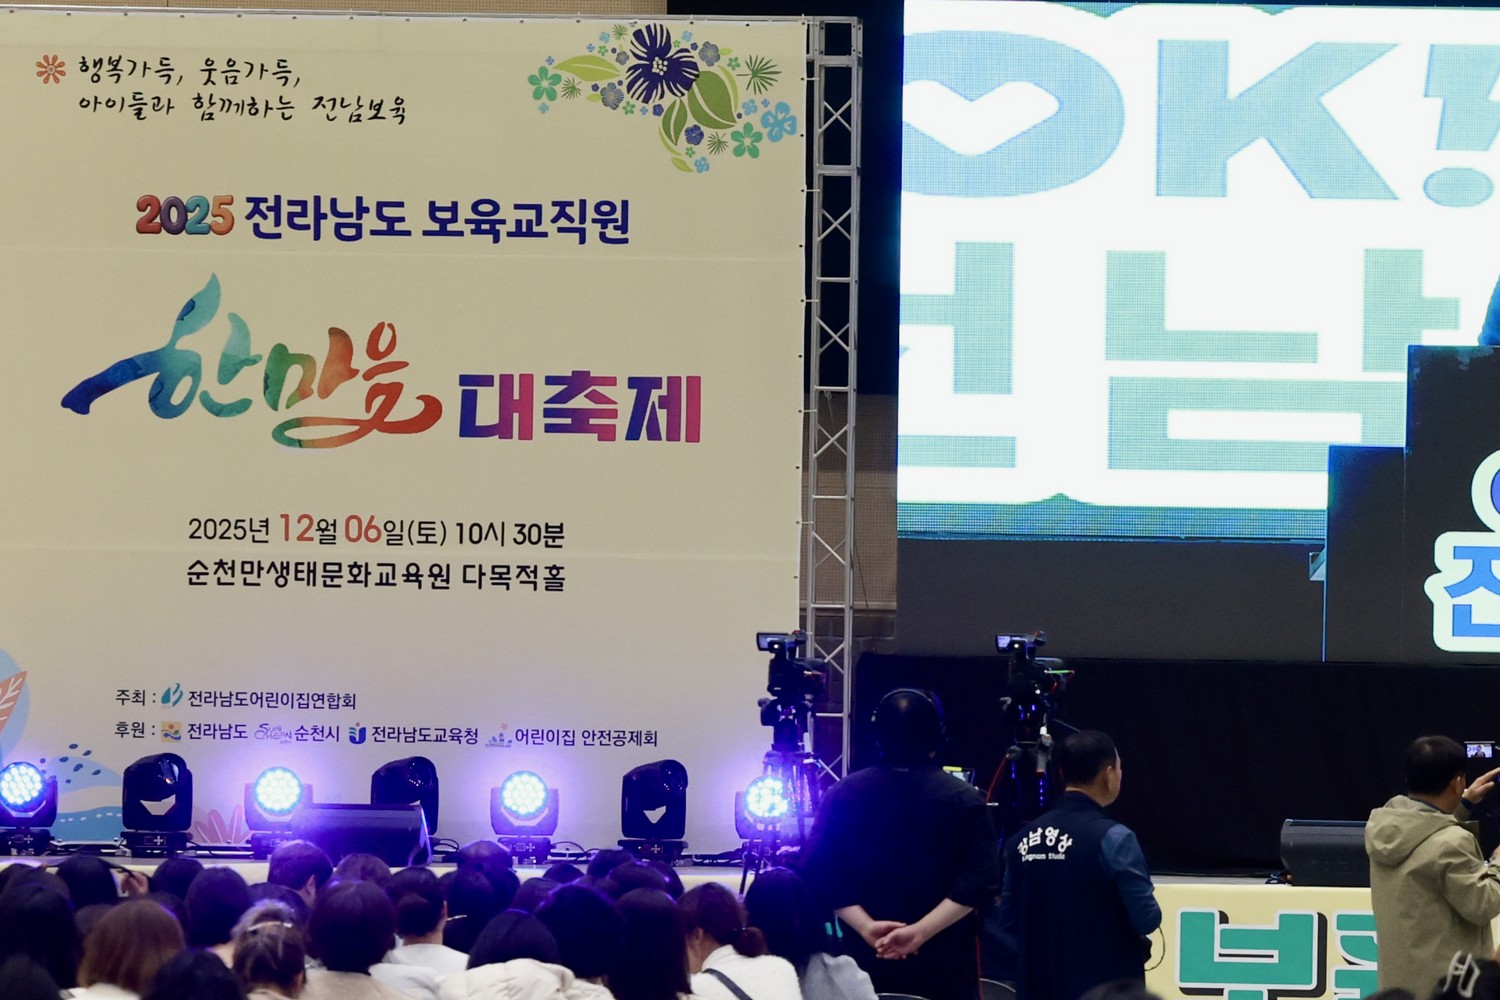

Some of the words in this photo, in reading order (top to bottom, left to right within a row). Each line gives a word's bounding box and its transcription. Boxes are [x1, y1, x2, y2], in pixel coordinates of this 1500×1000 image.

[79, 55, 183, 86] 행복가득,
[200, 57, 300, 88] 웃음가득,
[79, 92, 175, 120] 아이들과
[192, 92, 295, 121] 함께하는
[312, 95, 405, 125] 전남보육
[134, 193, 237, 238] 2025
[245, 195, 412, 242] 전라남도
[422, 199, 629, 245] 보육교직원
[457, 368, 703, 444] 대축제
[189, 517, 269, 543] 2025년
[280, 514, 336, 545] 12월
[345, 515, 446, 546] 06일(토)
[456, 521, 505, 547] 10시
[513, 522, 565, 548] 30분
[187, 558, 450, 590] 순천만생태문화교육원
[462, 564, 565, 592] 다목적홀
[116, 690, 145, 706] 주최
[188, 691, 356, 710] 전라남도어린이집연합회
[115, 722, 144, 738] 후원
[187, 723, 248, 740] 전라남도
[295, 725, 339, 742] 순천시
[372, 726, 478, 744] 전라남도교육청
[515, 729, 575, 746] 어린이집
[582, 730, 657, 747] 안전공제회
